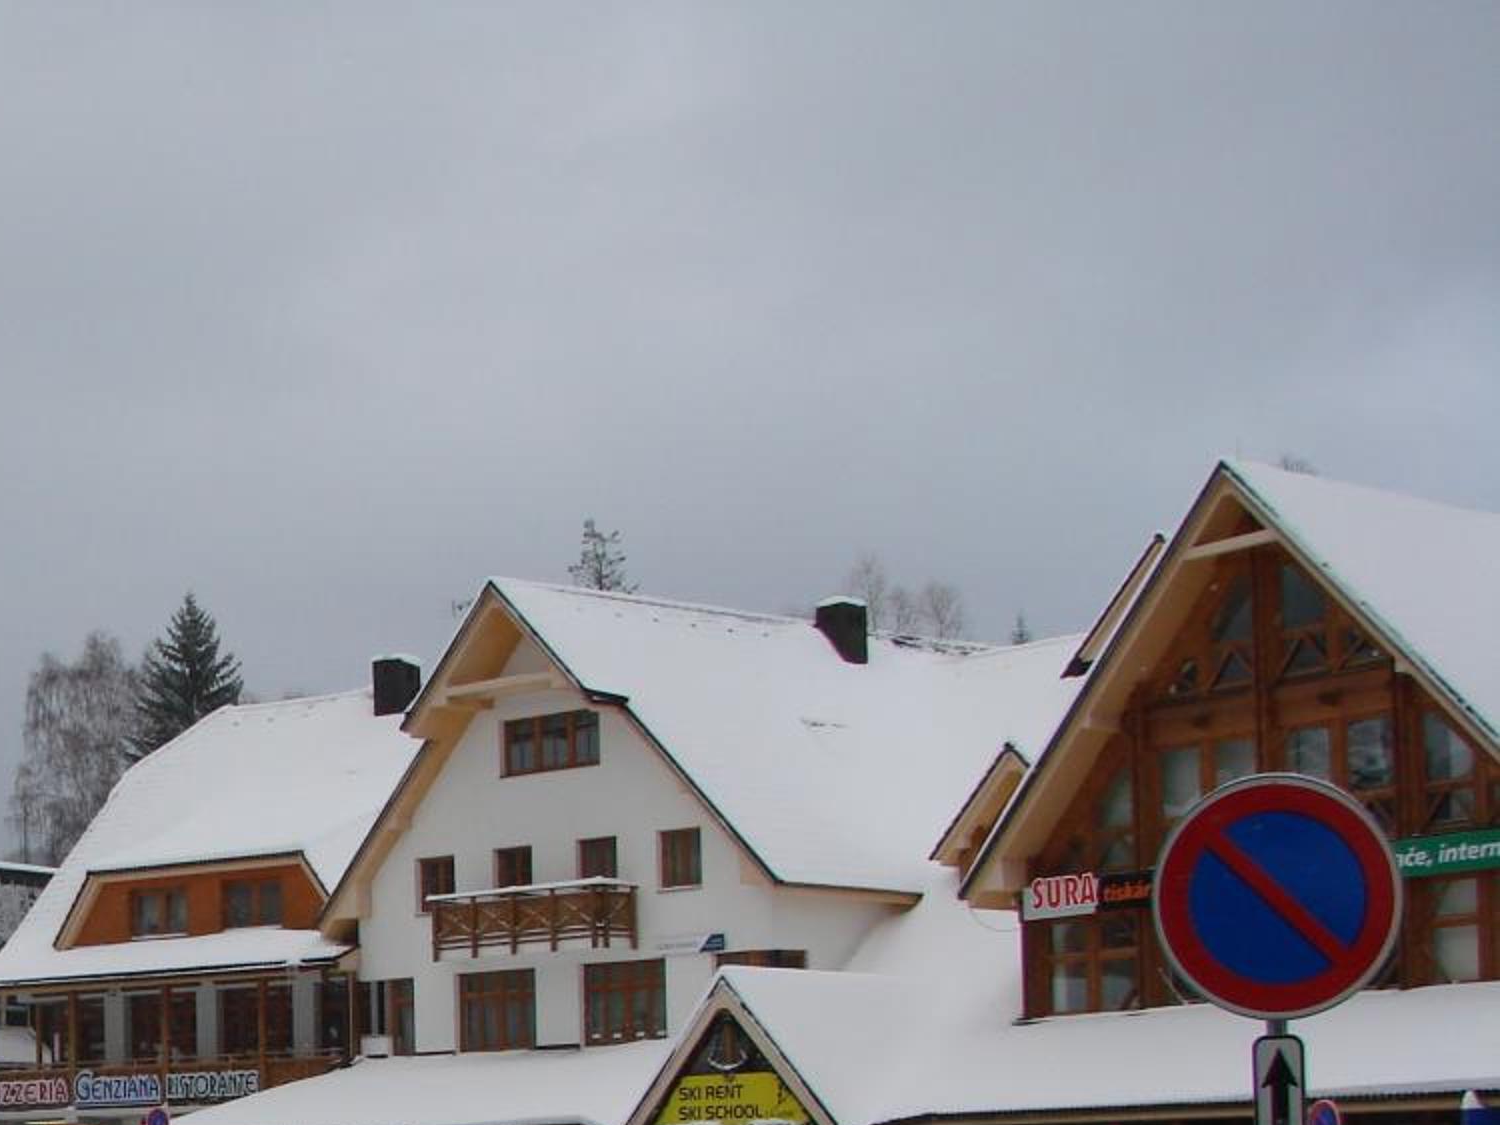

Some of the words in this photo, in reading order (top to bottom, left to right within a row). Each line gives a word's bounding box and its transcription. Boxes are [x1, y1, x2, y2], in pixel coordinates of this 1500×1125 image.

[1033, 873, 1097, 909] SURA
[74, 1071, 159, 1101] GENZIANA
[165, 1071, 259, 1098] RISTORANTE
[678, 1087, 701, 1101] SKI
[705, 1084, 743, 1099] RENT
[678, 1105, 701, 1120] SKI
[705, 1104, 764, 1119] SCHOOL
